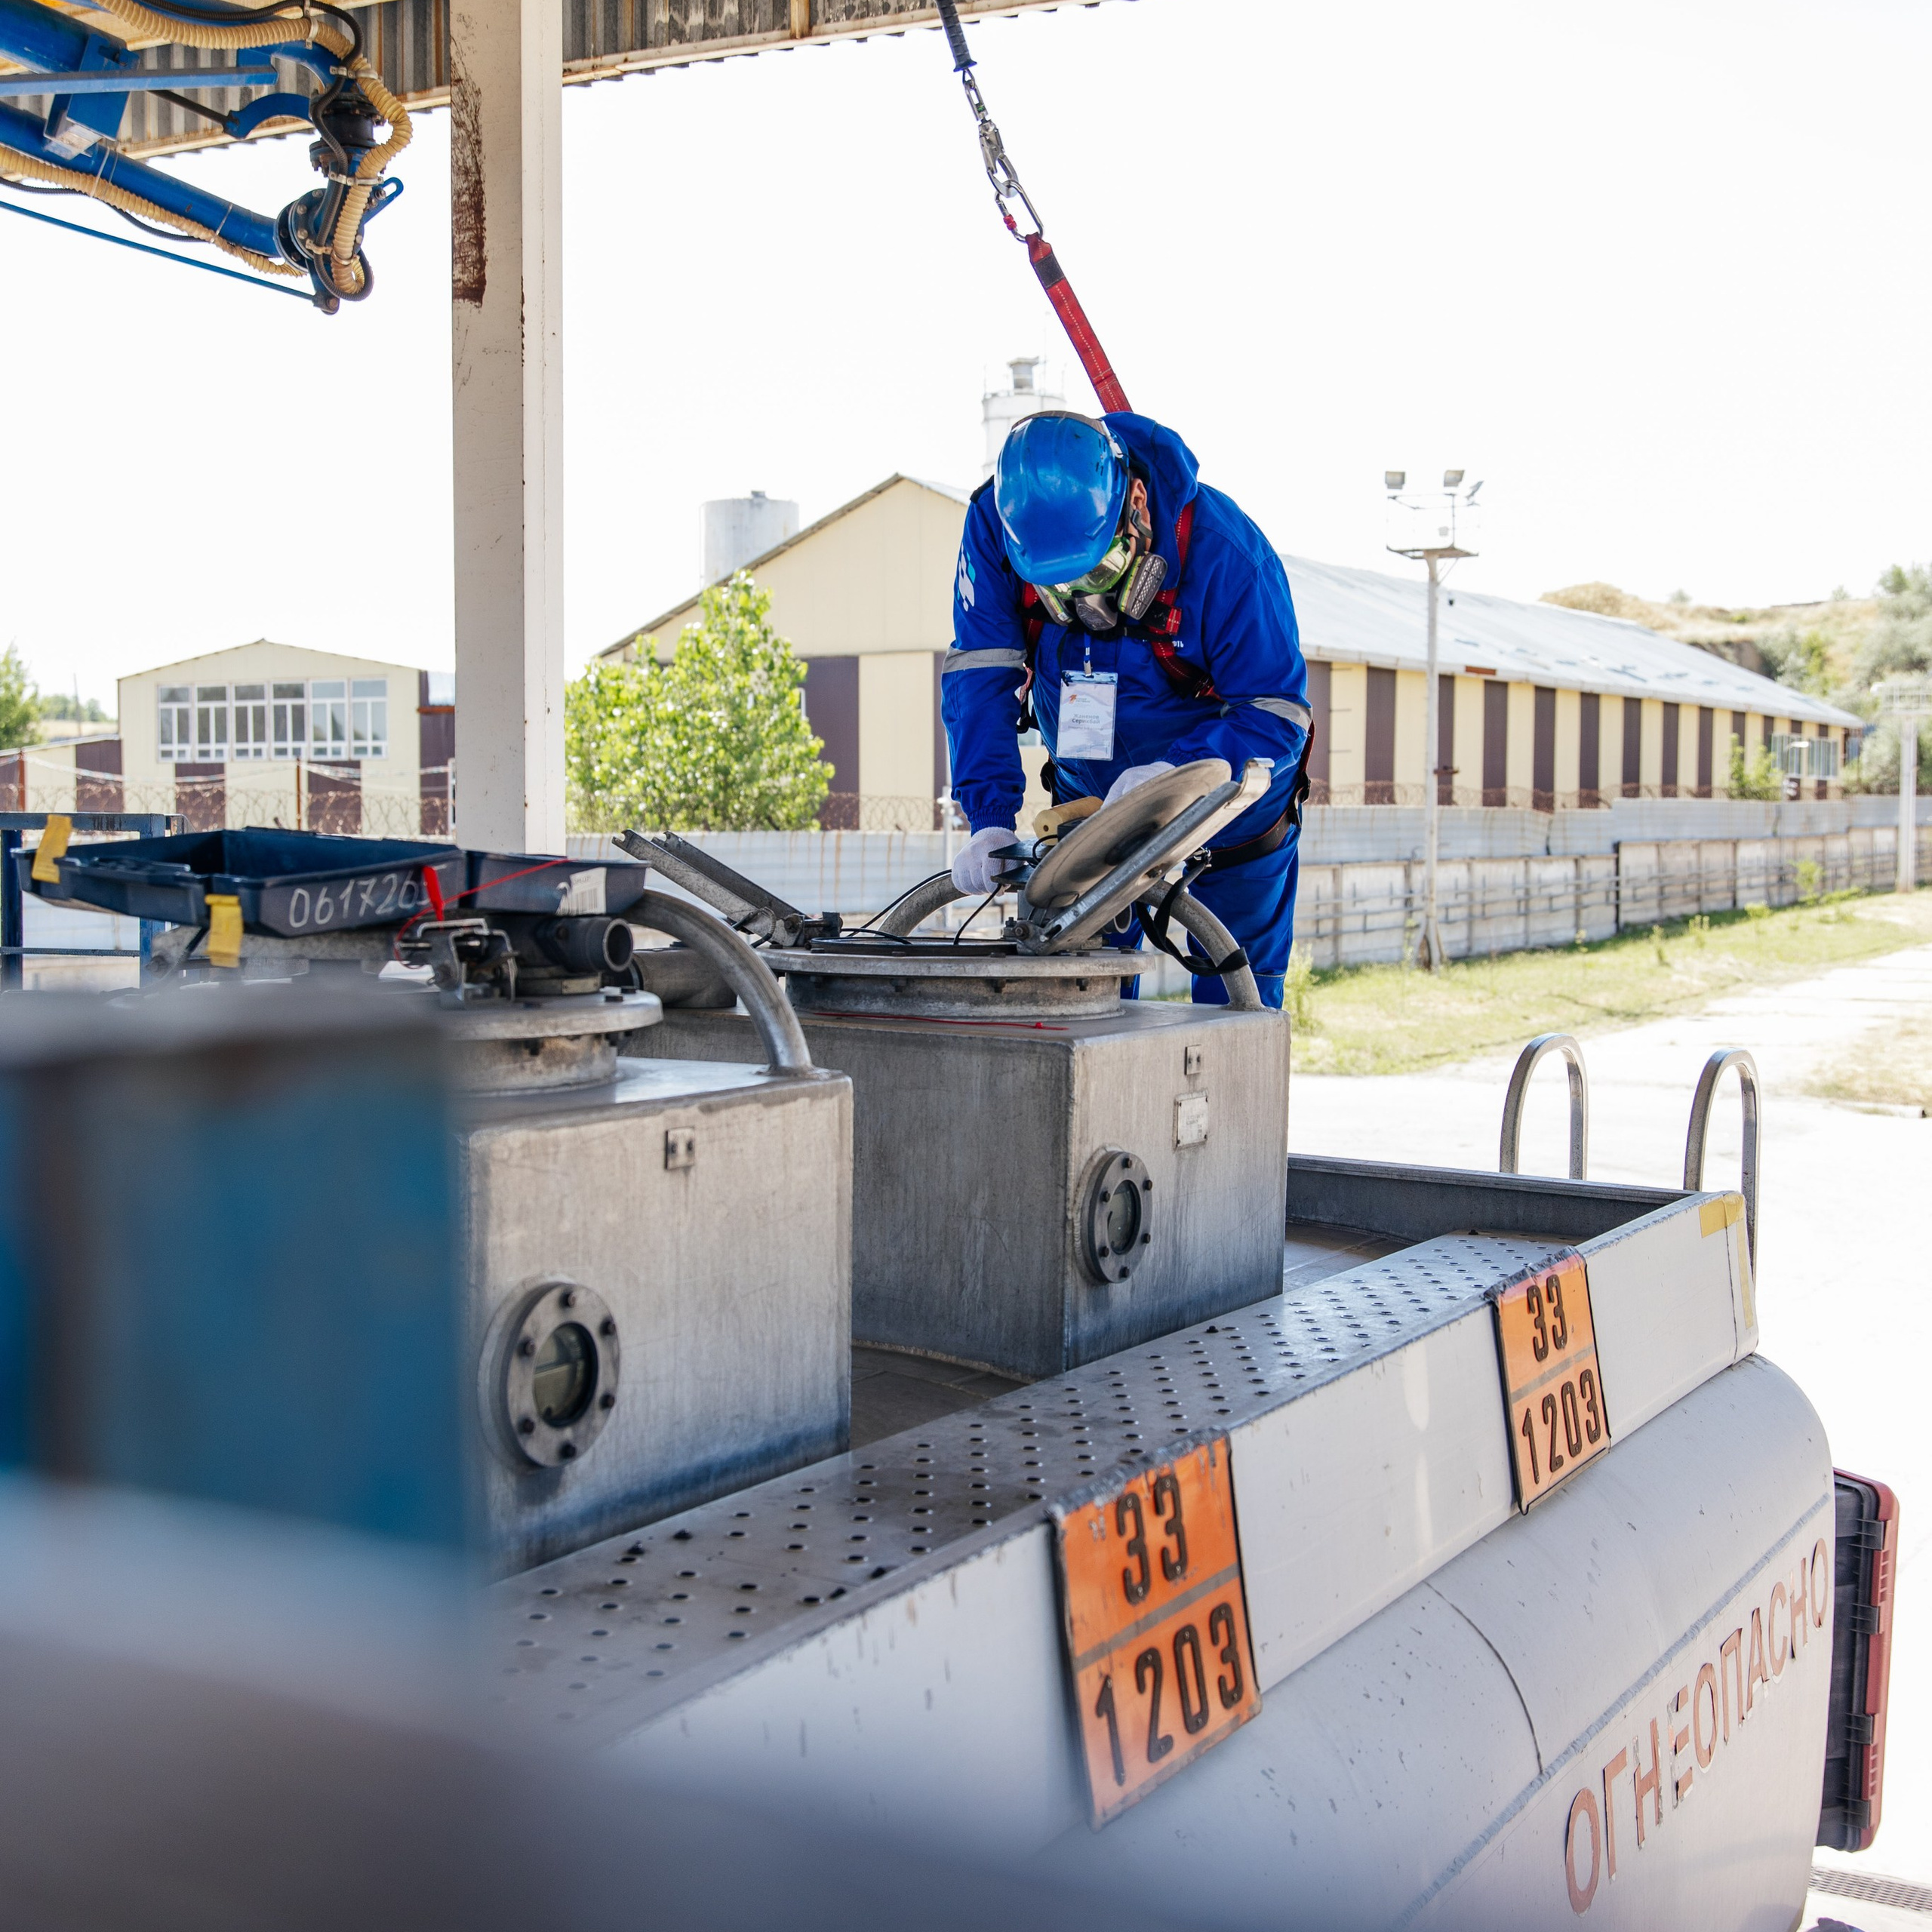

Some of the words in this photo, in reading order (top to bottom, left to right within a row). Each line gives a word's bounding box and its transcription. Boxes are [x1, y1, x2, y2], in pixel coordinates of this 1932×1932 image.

[1527, 1274, 1567, 1362] 33
[1522, 1369, 1601, 1484] 1203
[1117, 1474, 1187, 1604] 33
[1096, 1602, 1243, 1786] 1203
[1565, 1537, 1829, 1917] ОГНЕОПАСНО
